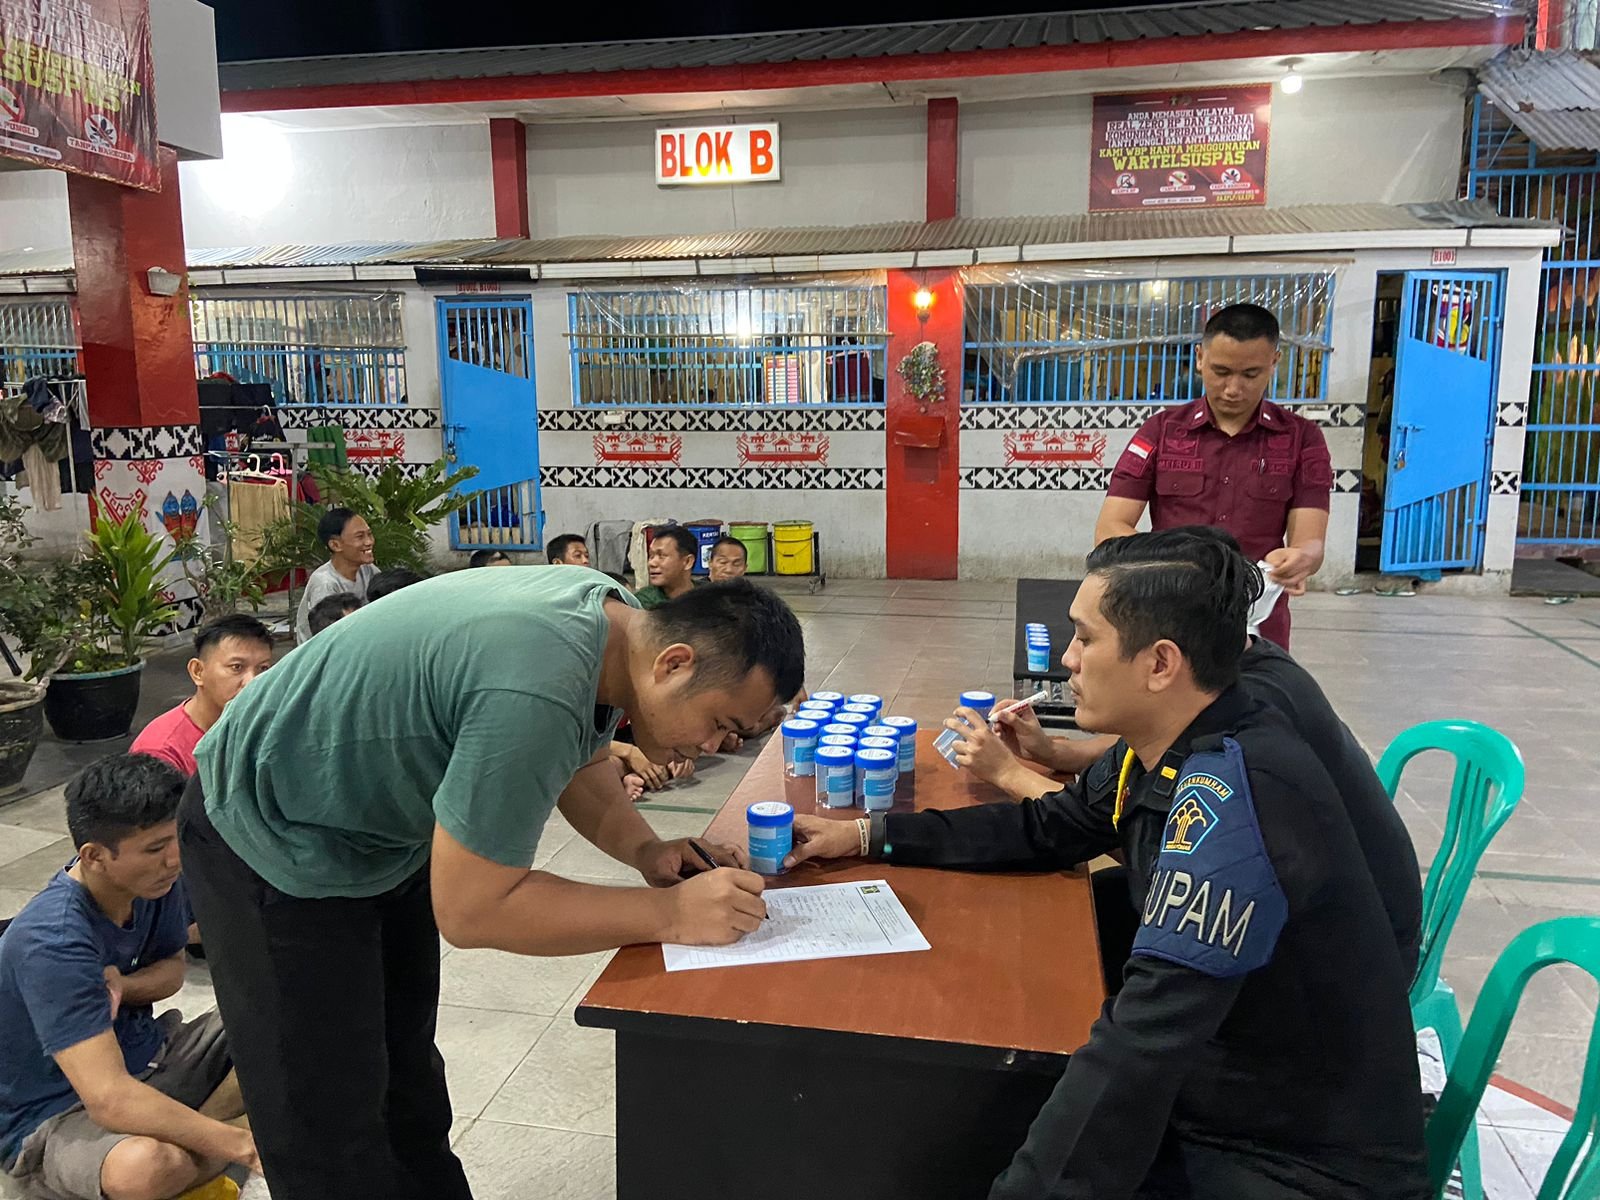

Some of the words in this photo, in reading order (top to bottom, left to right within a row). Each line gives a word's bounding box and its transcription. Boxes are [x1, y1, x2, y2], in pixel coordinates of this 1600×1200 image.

[1108, 121, 1135, 131] REAL
[1138, 120, 1164, 130] ZERO
[1167, 118, 1181, 129] HP
[1184, 117, 1205, 128] DAN
[1208, 113, 1253, 126] SARANA
[1127, 111, 1150, 121] ANDA
[1152, 109, 1194, 120] MEMASUKI
[1196, 106, 1235, 117] WILAYAH
[1107, 128, 1165, 141] KOMUNIKASI
[1168, 126, 1206, 137] PRIBADI
[1209, 122, 1253, 135] LAINNYA
[1133, 137, 1164, 147] PUNGLI
[1165, 136, 1183, 146] DAN
[1184, 134, 1206, 145] ANTI
[661, 131, 734, 178] BLOK
[749, 129, 774, 175] B
[1099, 147, 1123, 158] KAMI
[1125, 146, 1148, 157] WBP
[1150, 144, 1184, 155] HANYA
[1186, 140, 1260, 154] MENGGUNAKAN
[1112, 151, 1245, 171] WARTELSUSPAS
[1143, 870, 1255, 957] UPAM
